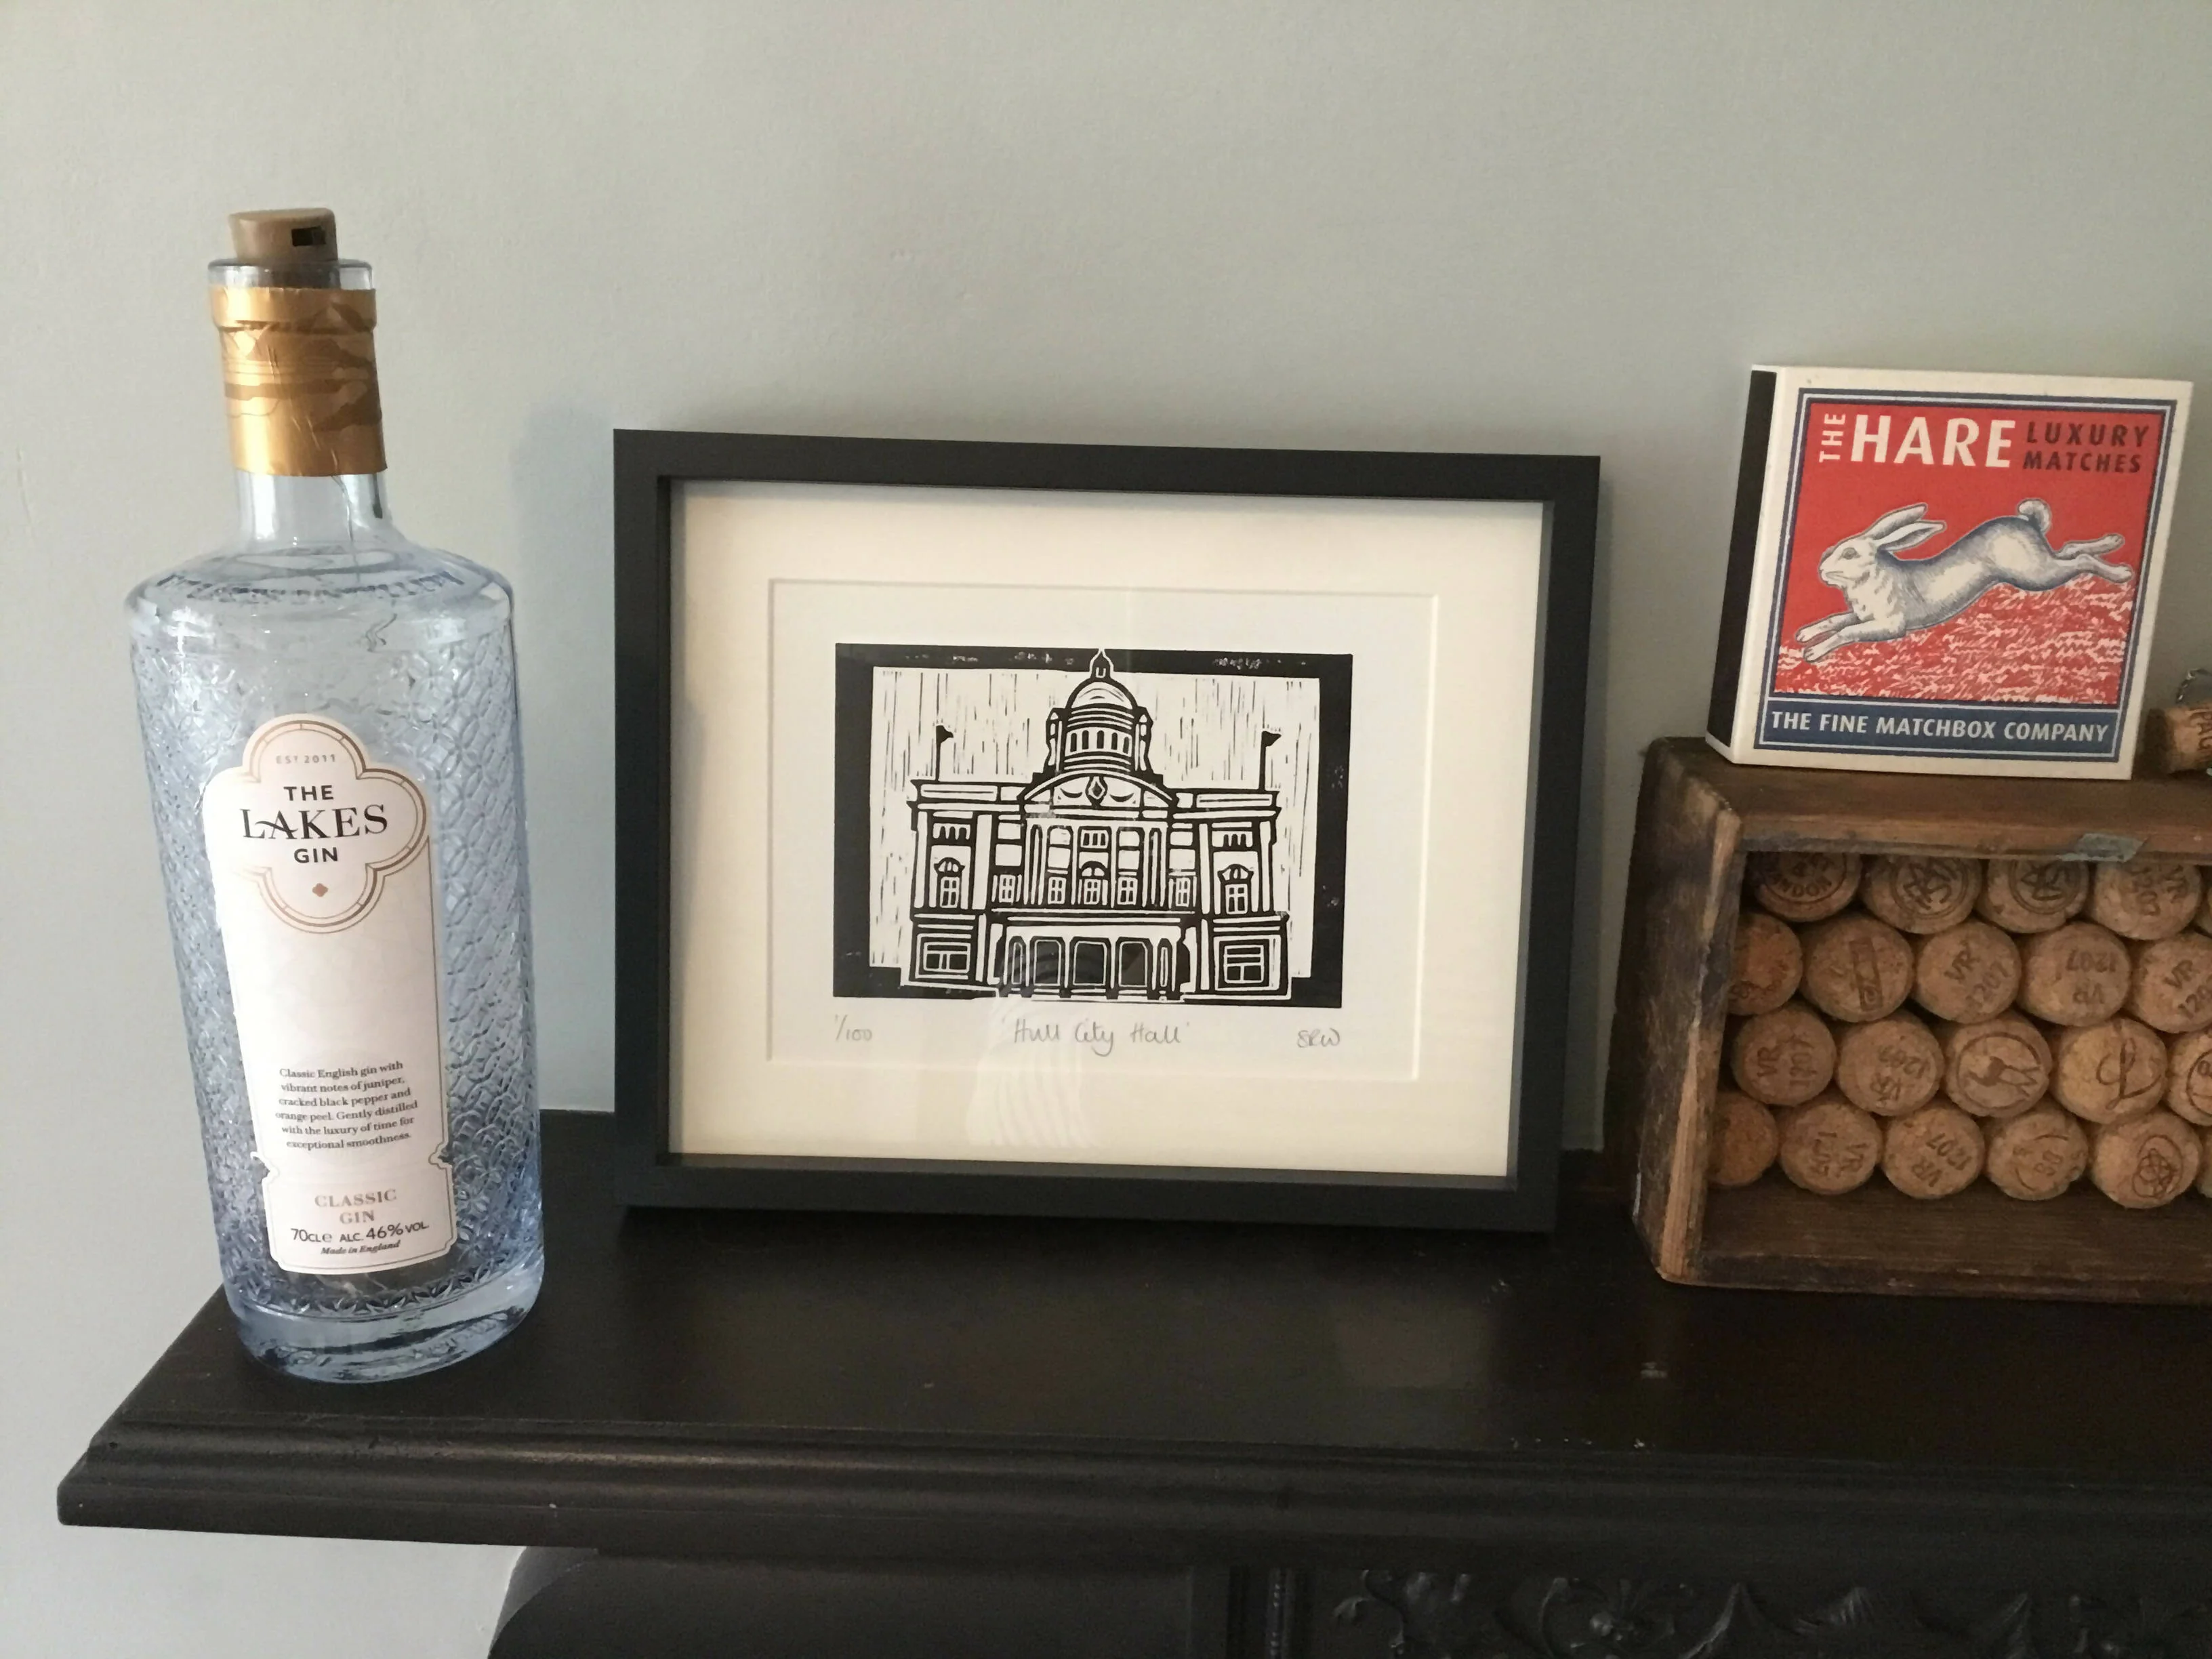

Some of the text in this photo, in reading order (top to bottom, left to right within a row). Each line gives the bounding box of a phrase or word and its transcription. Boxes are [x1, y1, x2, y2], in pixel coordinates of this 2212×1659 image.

[1819, 412, 2016, 468] THE HARE
[2026, 421, 2149, 447] LUXURY
[2023, 451, 2142, 474] MATCHES
[1771, 711, 2109, 743] THE FINE MATCHBOX COMPANY
[304, 754, 337, 764] 2011
[283, 785, 334, 801] THE
[239, 804, 388, 840] LAKES
[293, 847, 338, 863] GIN
[279, 1061, 403, 1080] Classic English gin with
[281, 1083, 317, 1092] vibrant
[319, 1084, 348, 1092] notes
[350, 1080, 363, 1090] of
[279, 1087, 411, 1107] cracked black pepper and
[275, 1112, 307, 1122] orange
[336, 1109, 372, 1120] Gently
[375, 1099, 418, 1116] distilled
[281, 1116, 414, 1136] with the luxury of time for
[286, 1139, 344, 1151] exceptional
[314, 1189, 397, 1208] CLASSIC
[340, 1210, 375, 1224] GIN
[348, 1246, 357, 1254] in
[359, 1239, 401, 1254] England
